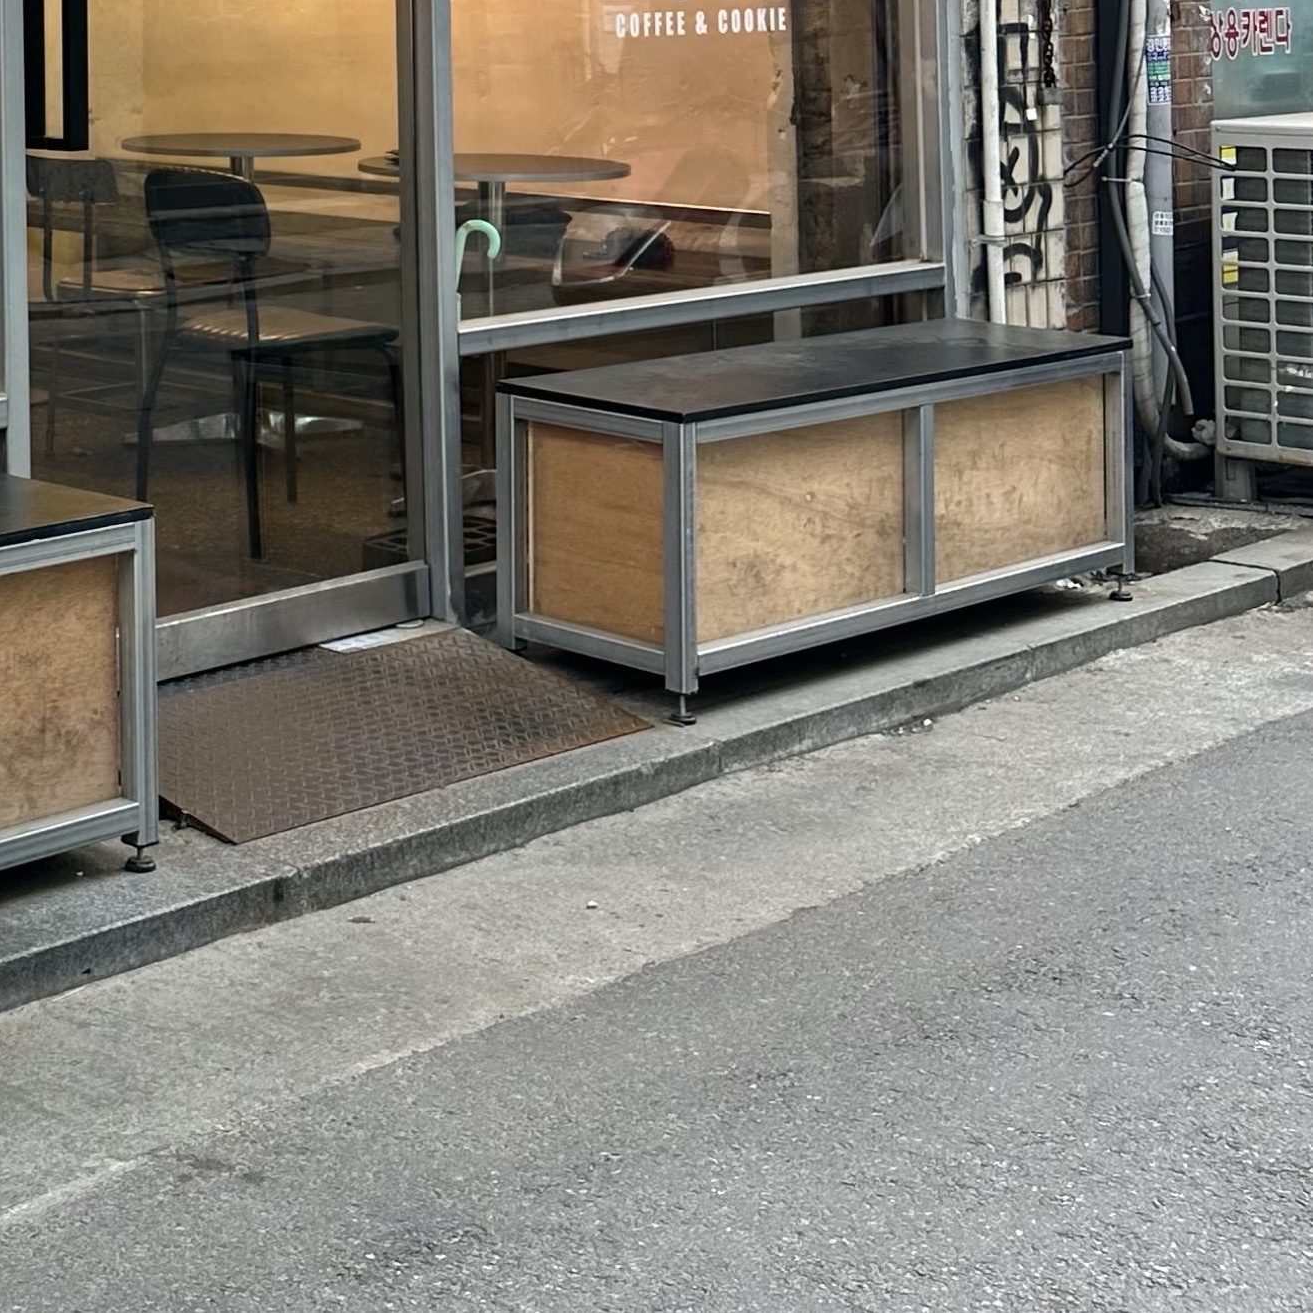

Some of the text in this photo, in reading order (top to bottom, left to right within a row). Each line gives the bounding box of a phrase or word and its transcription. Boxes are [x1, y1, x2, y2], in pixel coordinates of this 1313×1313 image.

[615, 6, 788, 39] COFFEE & COOKIE
